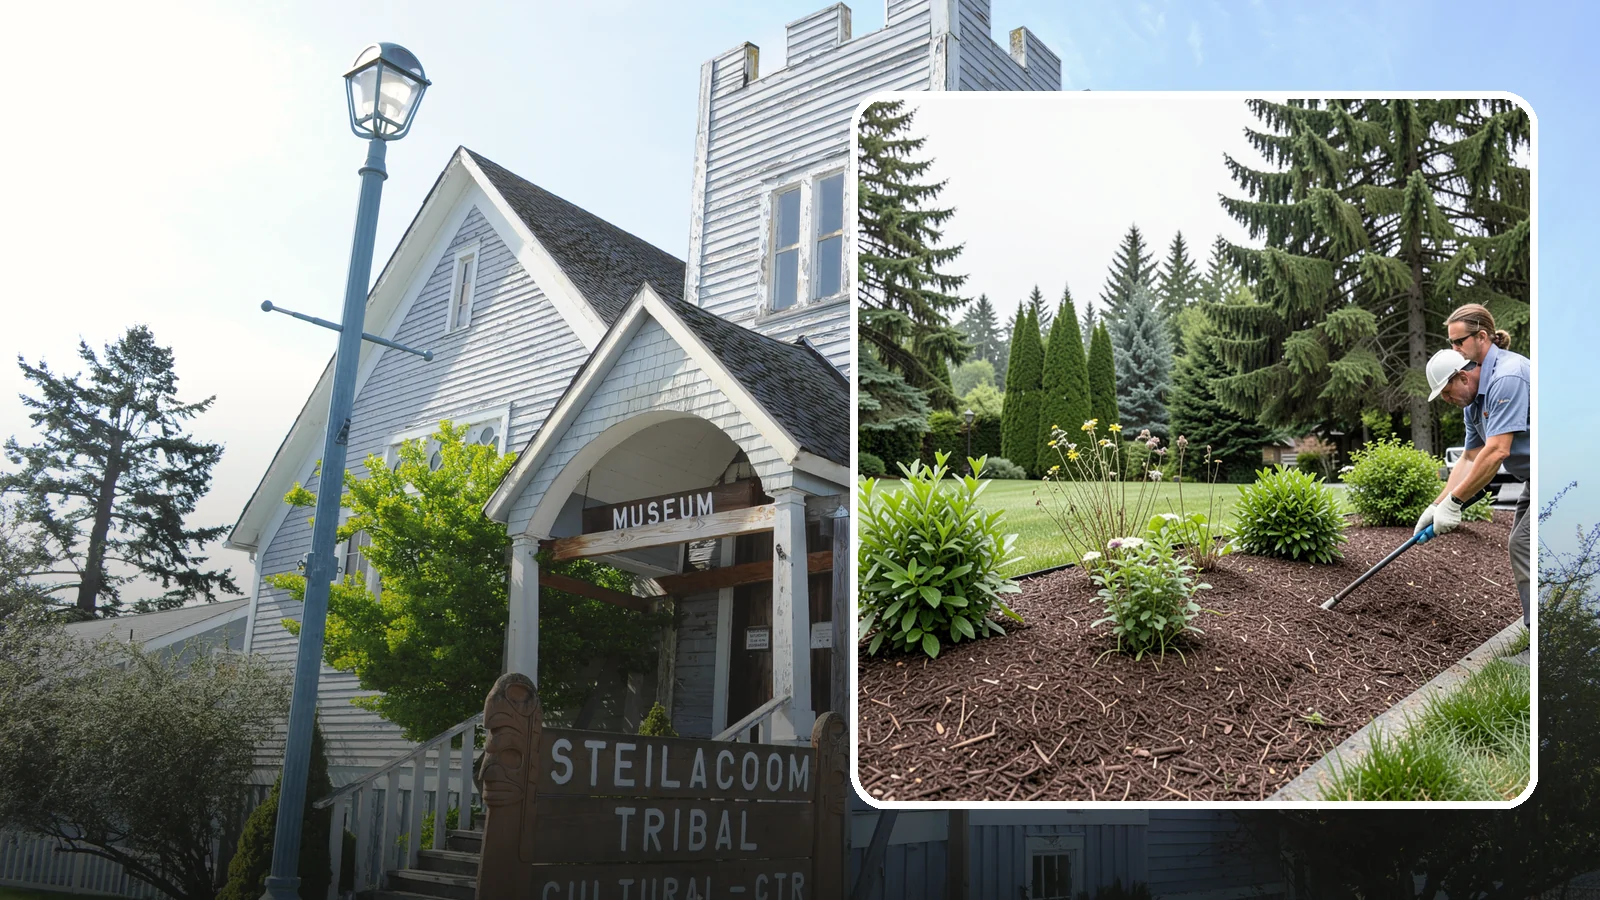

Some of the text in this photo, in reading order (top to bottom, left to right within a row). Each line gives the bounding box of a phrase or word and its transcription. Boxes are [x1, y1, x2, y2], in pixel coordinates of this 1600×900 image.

[612, 491, 714, 531] MUSEUM
[550, 738, 810, 793] STEILACOOM
[614, 806, 757, 852] TRIBAL
